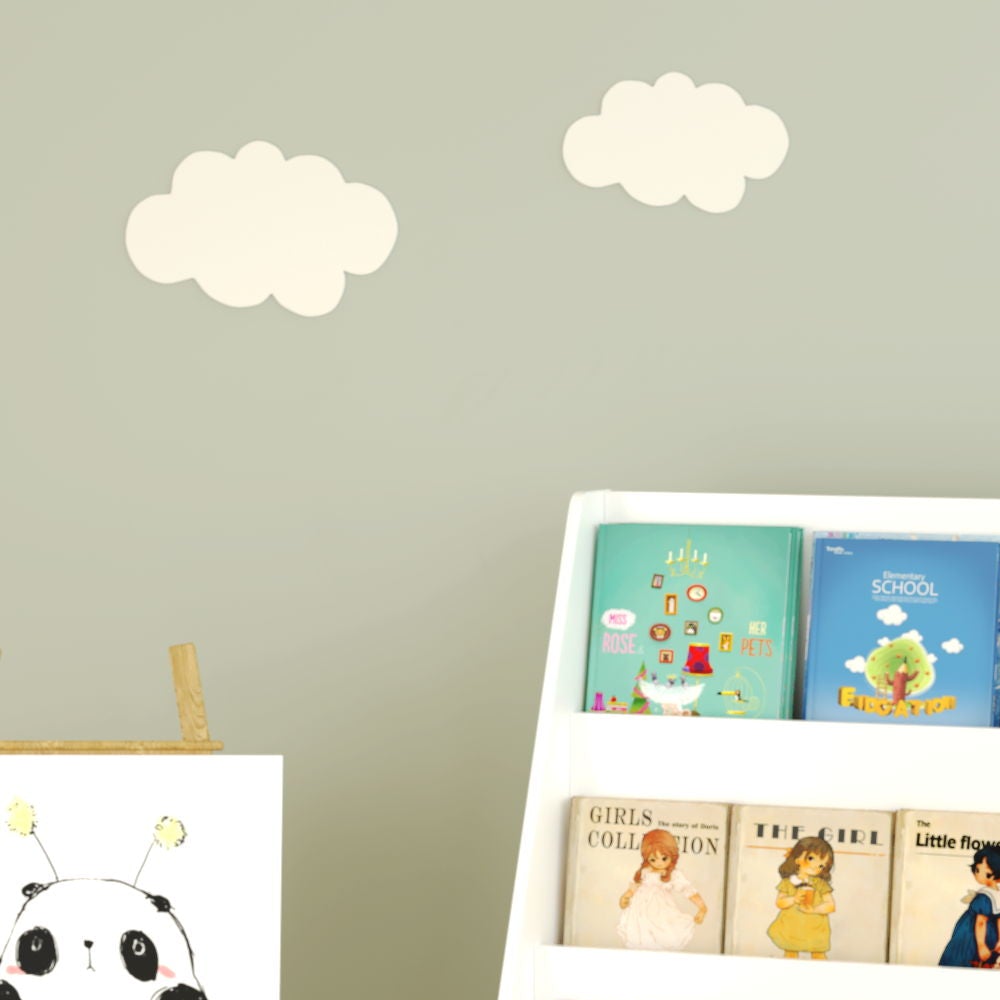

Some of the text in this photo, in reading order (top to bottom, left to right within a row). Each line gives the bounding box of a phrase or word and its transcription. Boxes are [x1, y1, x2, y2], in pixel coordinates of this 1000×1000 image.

[882, 570, 926, 581] Elementary
[871, 579, 939, 597] SCHOOL
[608, 613, 628, 625] MISS
[748, 621, 767, 636] HER
[602, 632, 638, 655] ROSE
[740, 638, 773, 657] PETS
[590, 805, 653, 827] GIRLS
[657, 820, 670, 828] The
[917, 820, 931, 828] The
[754, 823, 806, 840] THE
[818, 827, 884, 846] GIRL
[588, 829, 719, 855] COLLION
[916, 833, 956, 849] Little
